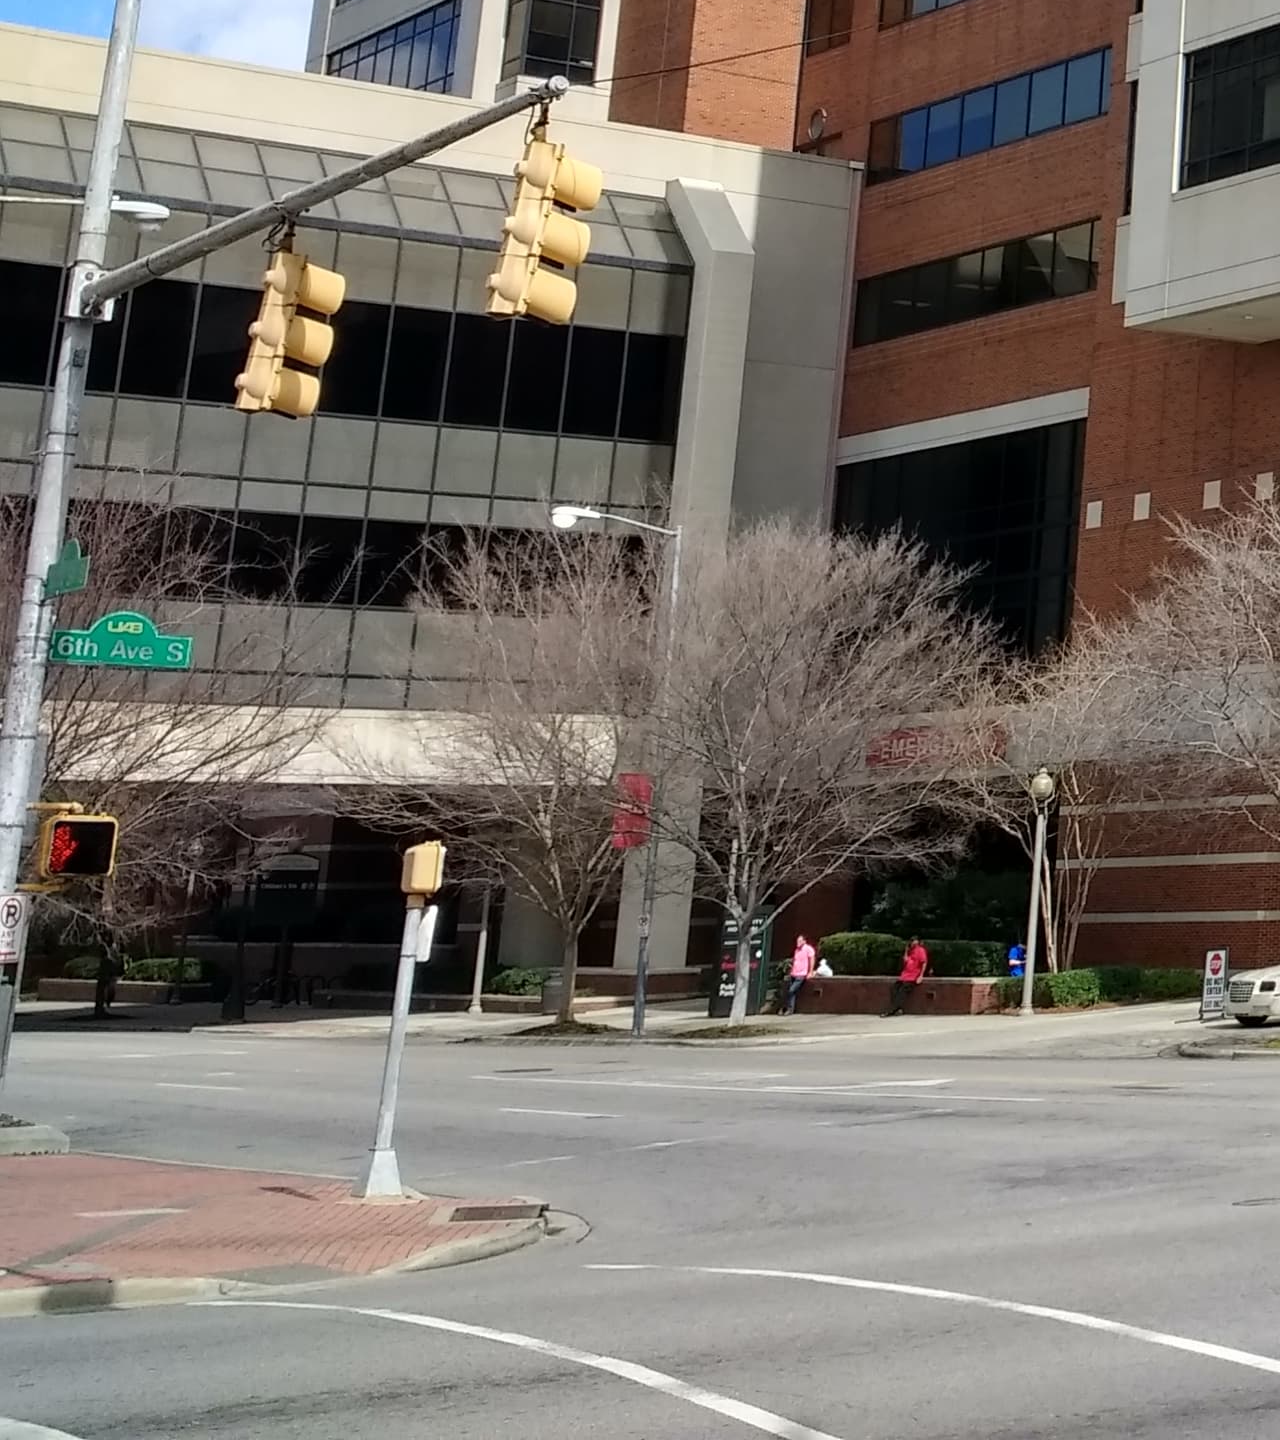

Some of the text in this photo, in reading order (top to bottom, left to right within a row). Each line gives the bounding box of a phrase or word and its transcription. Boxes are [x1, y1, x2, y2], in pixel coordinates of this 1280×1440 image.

[107, 621, 143, 634] UAB
[57, 636, 184, 662] 6th Ave S
